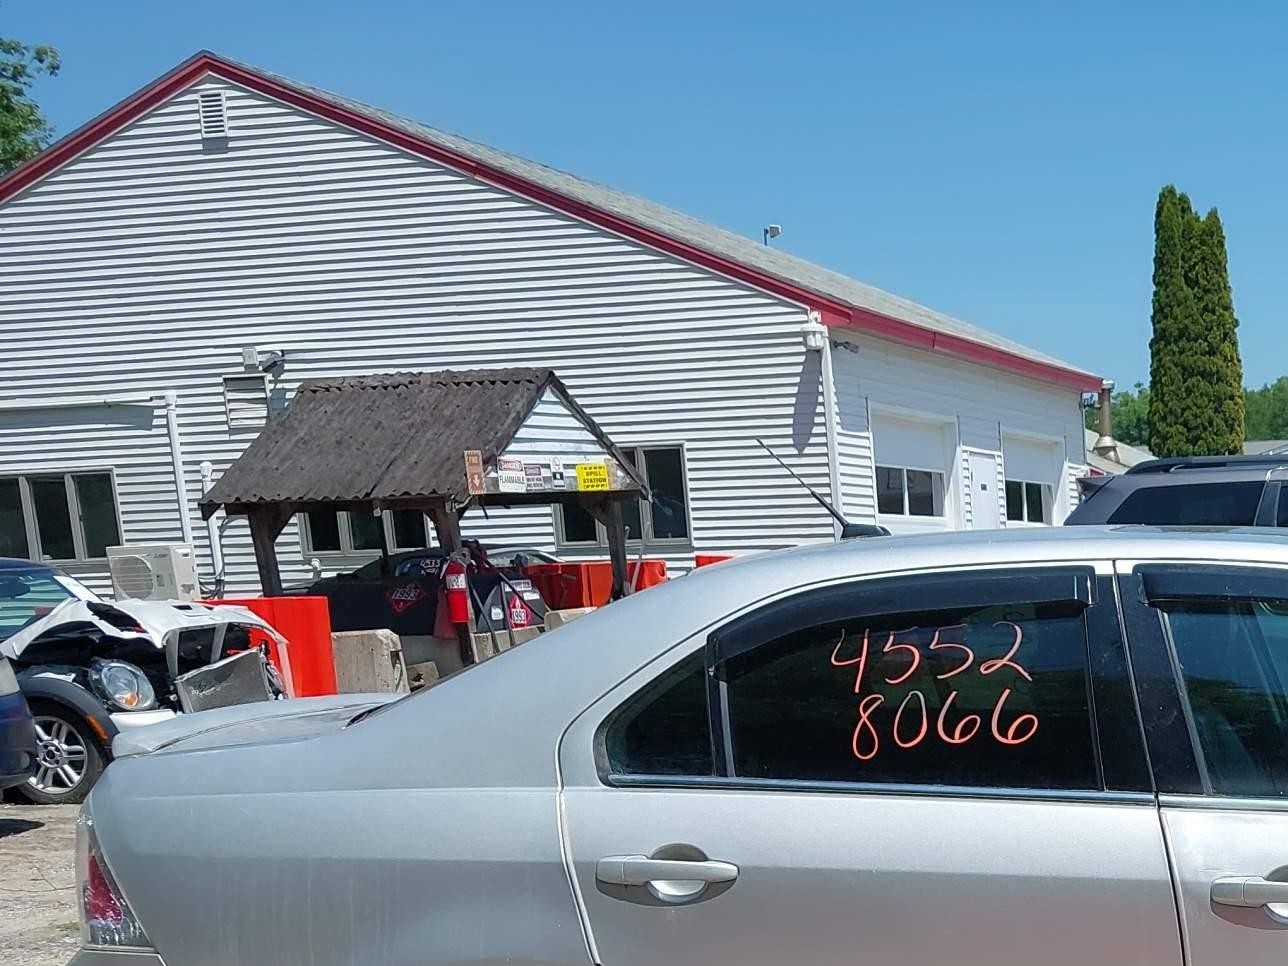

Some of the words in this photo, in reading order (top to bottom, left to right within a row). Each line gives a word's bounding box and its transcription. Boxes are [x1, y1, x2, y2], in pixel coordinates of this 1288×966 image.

[511, 610, 525, 622] 1993
[831, 621, 1033, 694] 4552
[853, 688, 1039, 760] 8066
